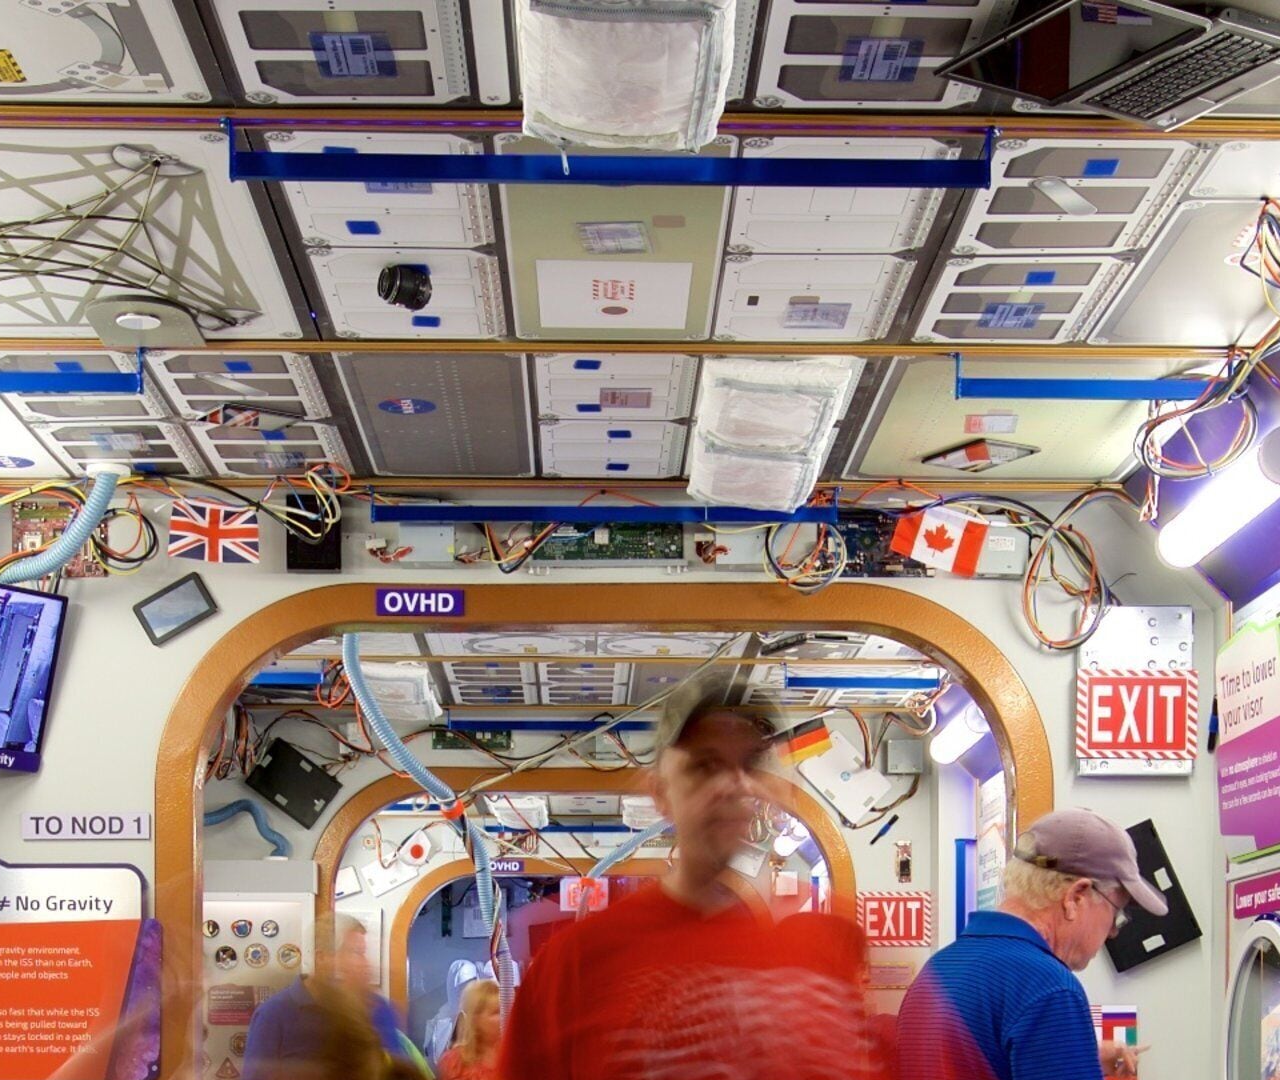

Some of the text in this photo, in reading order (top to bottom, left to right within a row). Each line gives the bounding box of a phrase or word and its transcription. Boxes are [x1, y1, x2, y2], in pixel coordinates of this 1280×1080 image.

[384, 592, 454, 612] OVHD
[1221, 657, 1276, 699] Time to lower
[1092, 685, 1181, 743] EXIT
[1223, 696, 1263, 734] your visor
[30, 816, 142, 834] TO NOD 1
[490, 861, 520, 871] OVHD
[16, 896, 39, 911] No
[46, 895, 113, 914] Gravity
[1236, 894, 1254, 909] Lower
[1254, 890, 1267, 908] your
[866, 901, 920, 937] EXIT
